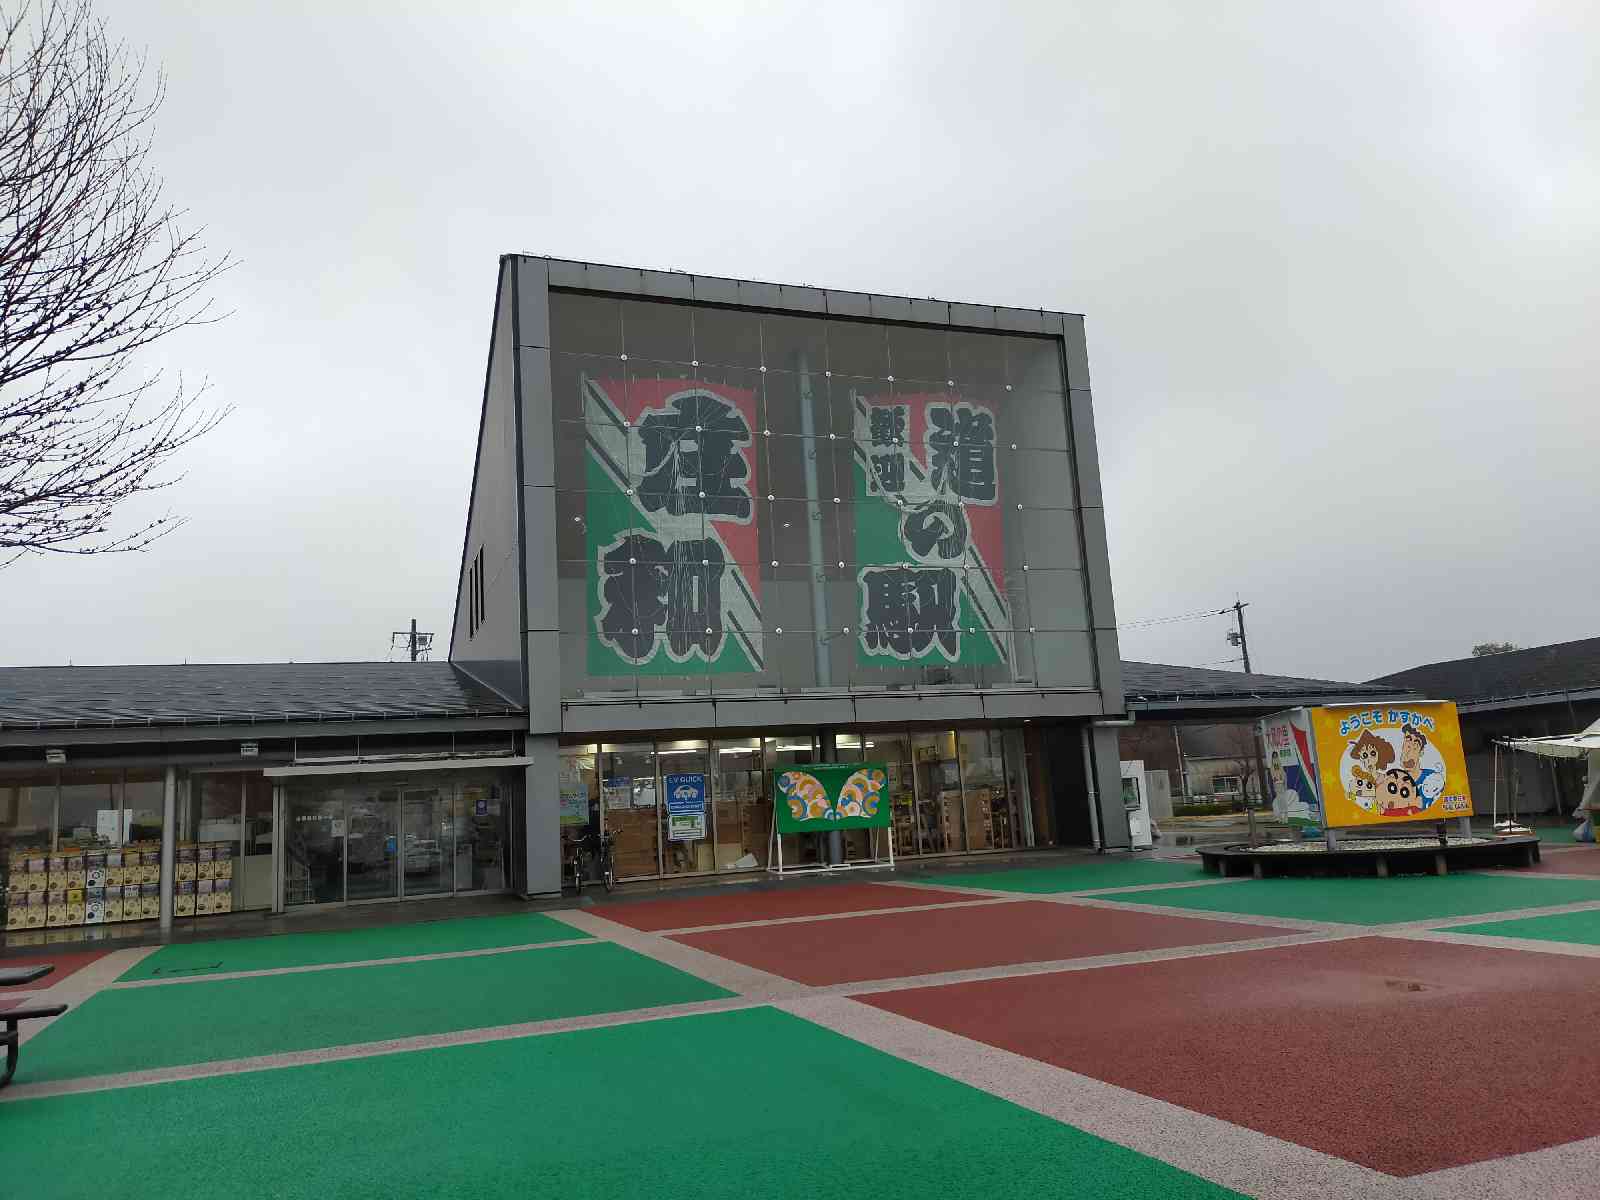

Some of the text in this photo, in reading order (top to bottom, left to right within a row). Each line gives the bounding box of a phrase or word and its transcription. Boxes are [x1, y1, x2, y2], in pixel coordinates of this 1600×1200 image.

[1340, 711, 1383, 735] ようこそ
[680, 775, 703, 784] QUICK
